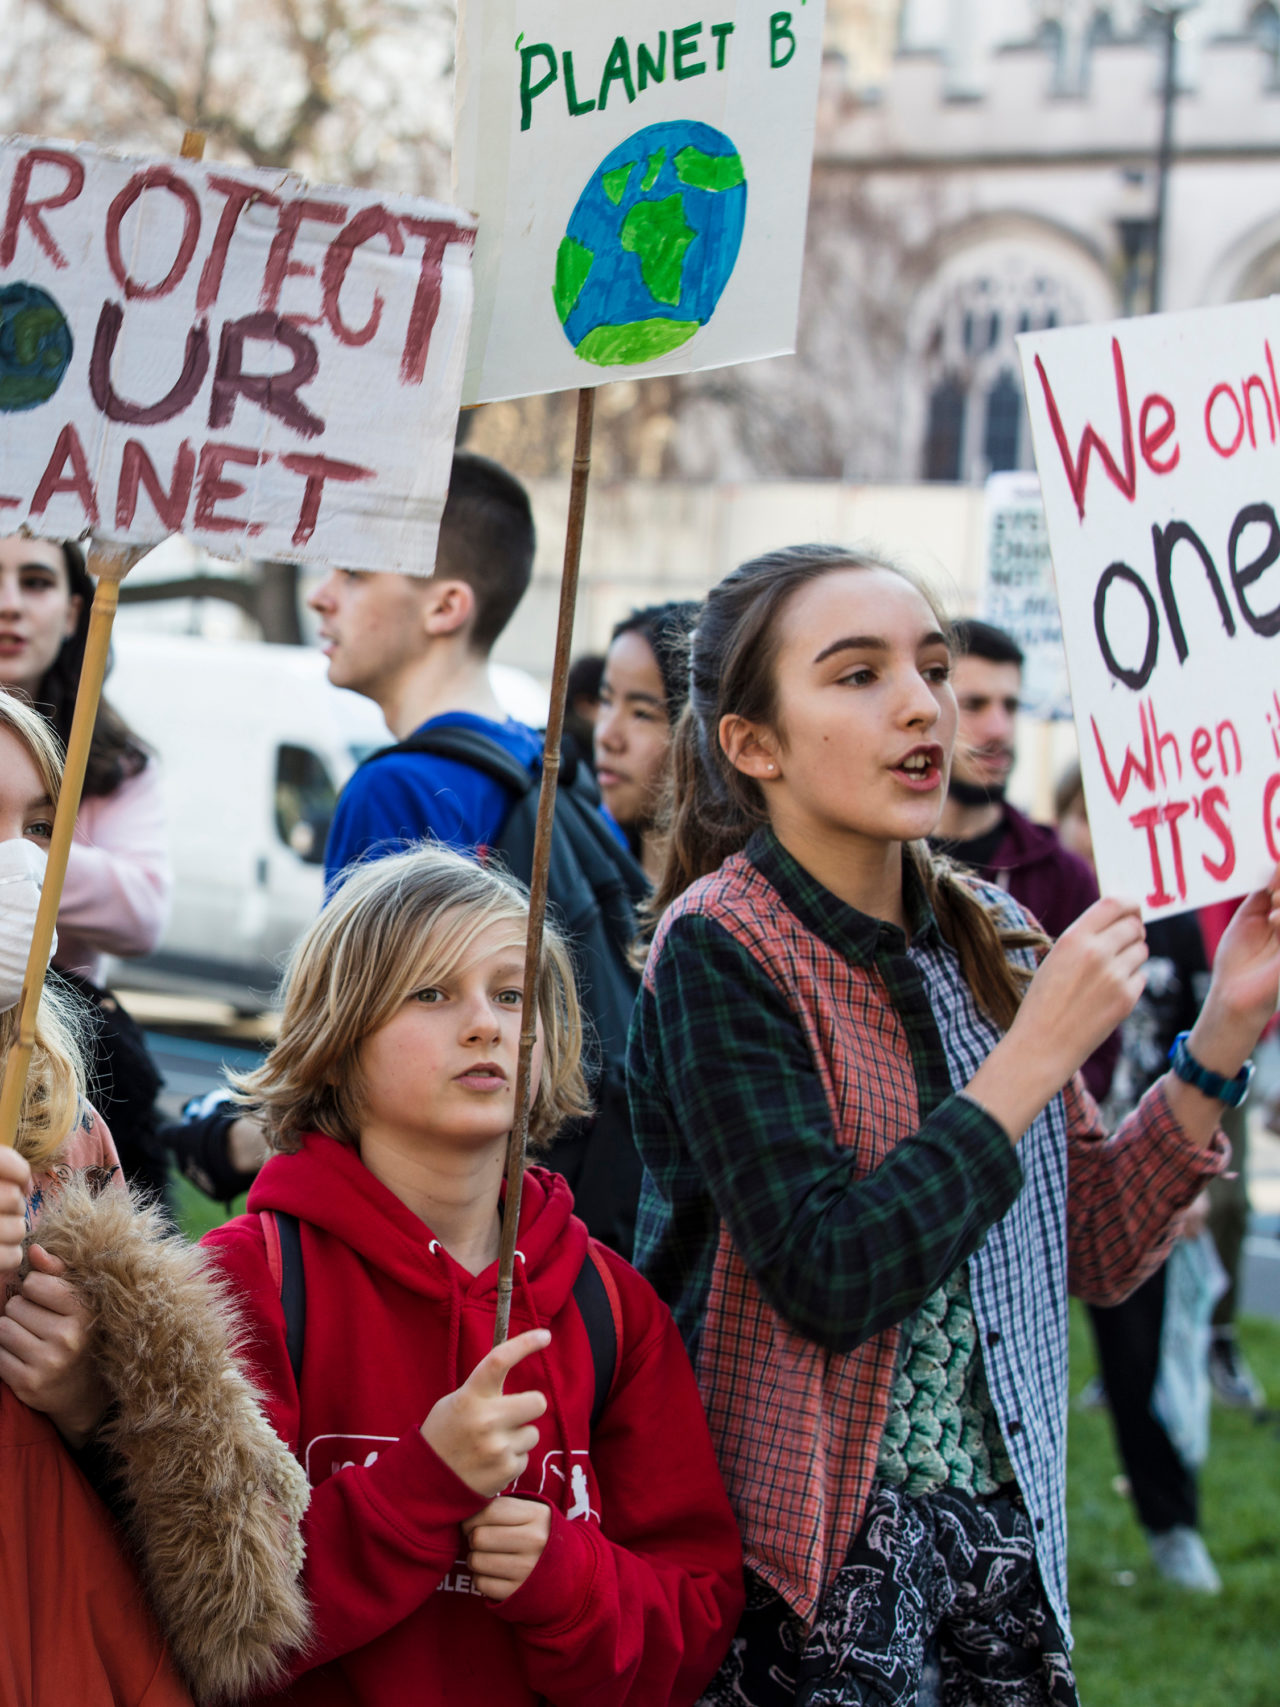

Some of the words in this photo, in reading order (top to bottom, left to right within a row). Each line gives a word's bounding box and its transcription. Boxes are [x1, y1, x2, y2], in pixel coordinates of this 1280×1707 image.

[1034, 336, 1180, 527] We
[1094, 501, 1280, 691] one
[1090, 696, 1242, 806] When
[1129, 786, 1236, 908] IT'S
